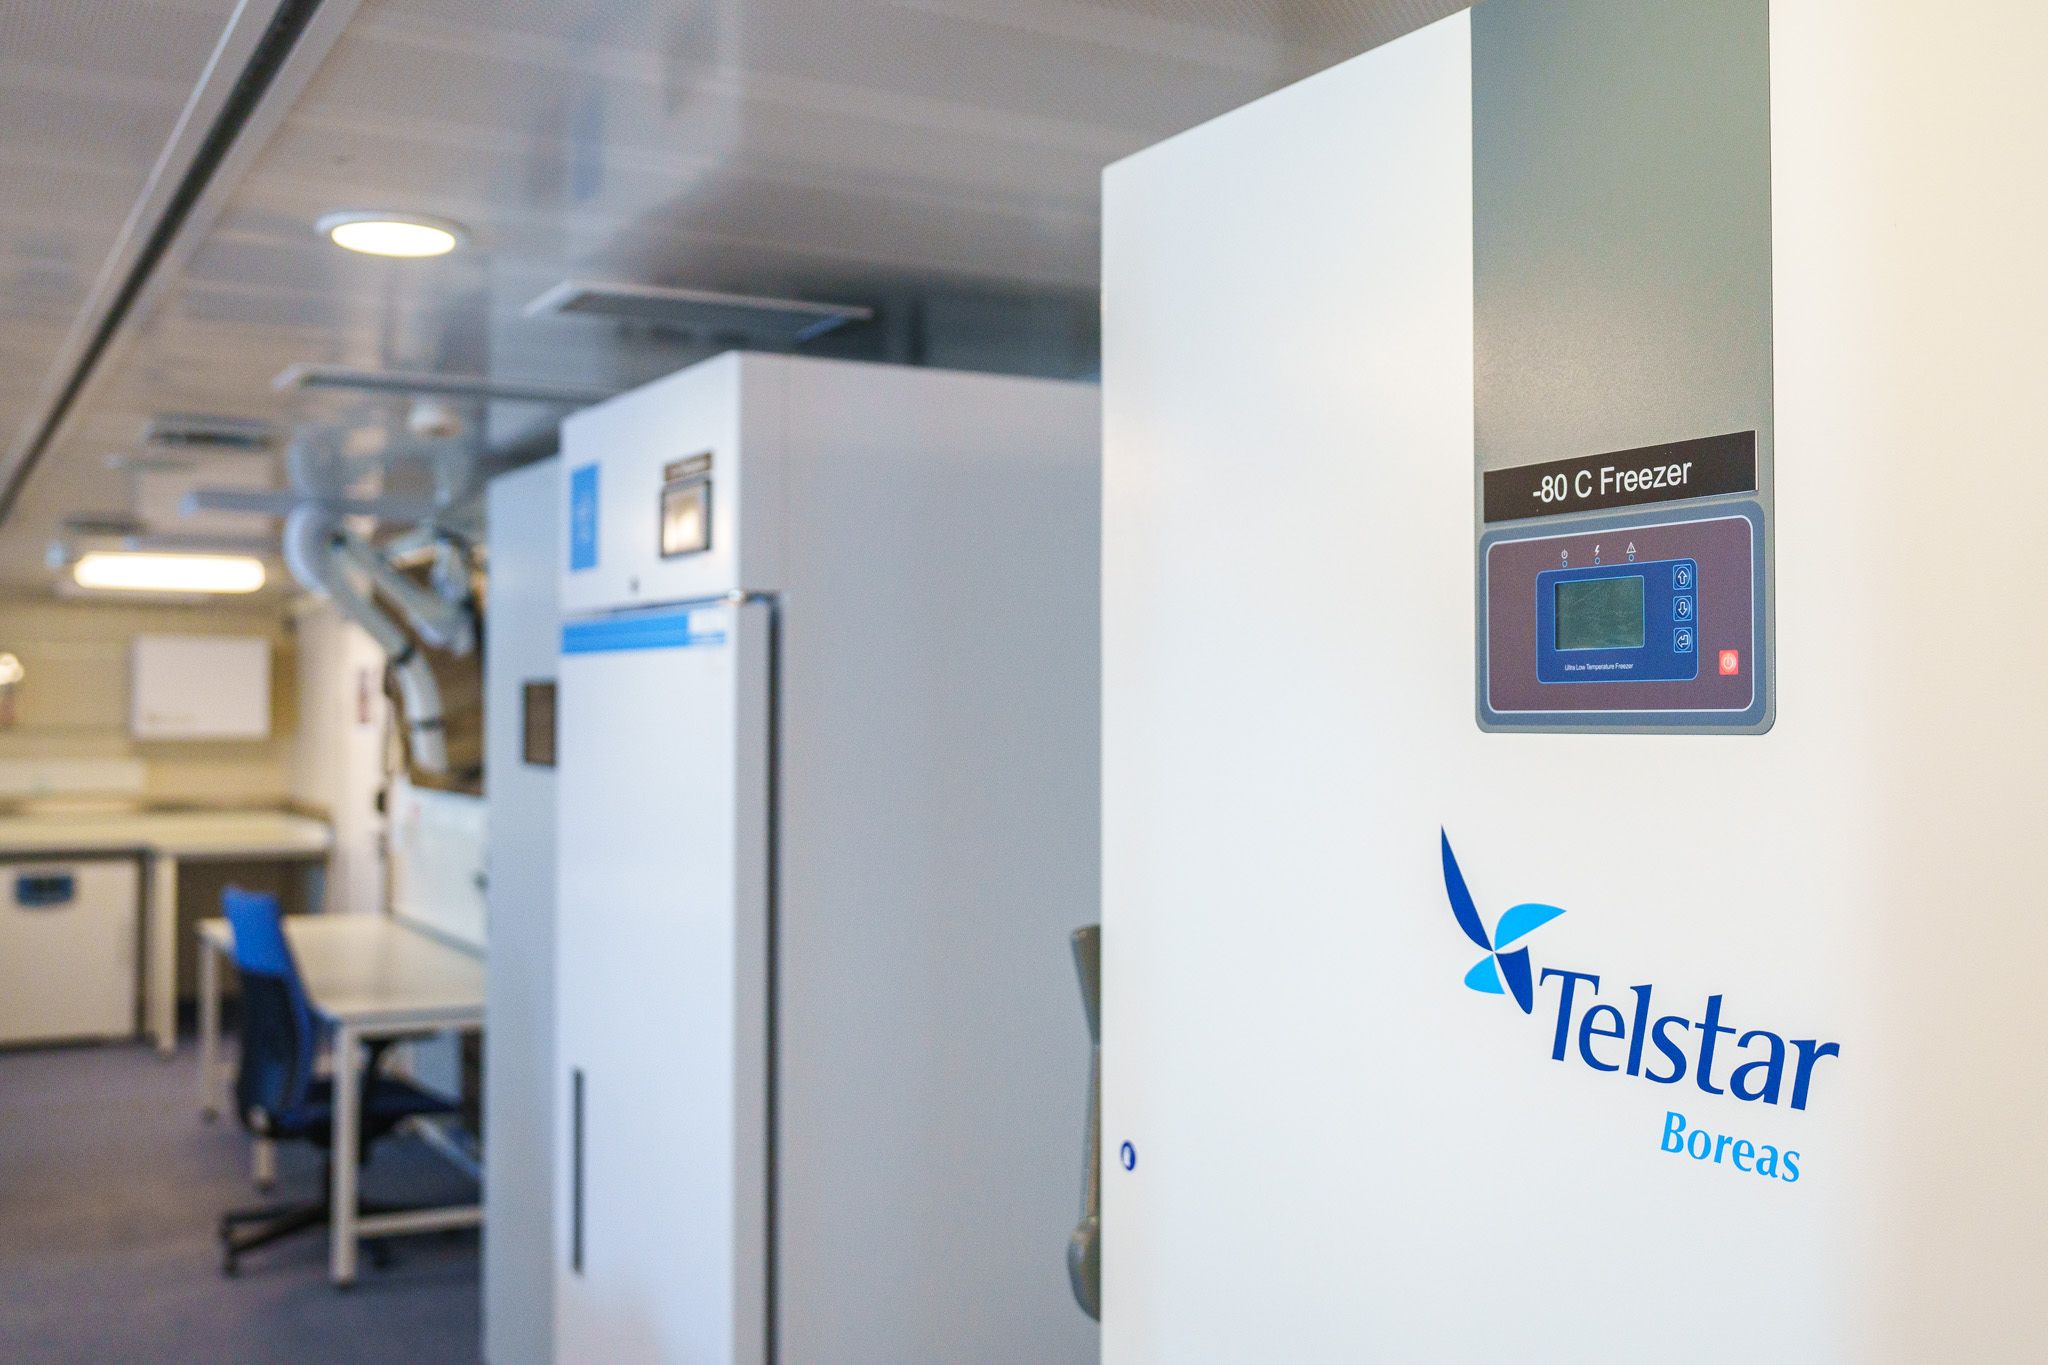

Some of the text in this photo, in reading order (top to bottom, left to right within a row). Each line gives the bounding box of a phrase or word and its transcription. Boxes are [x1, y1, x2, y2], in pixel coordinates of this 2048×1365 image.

[1533, 462, 1692, 503] -80 C Freezer
[1586, 663, 1614, 671] Temperature
[1615, 662, 1634, 670] Freezer
[1539, 967, 1841, 1111] Telstar
[1660, 1110, 1801, 1183] Boreas
